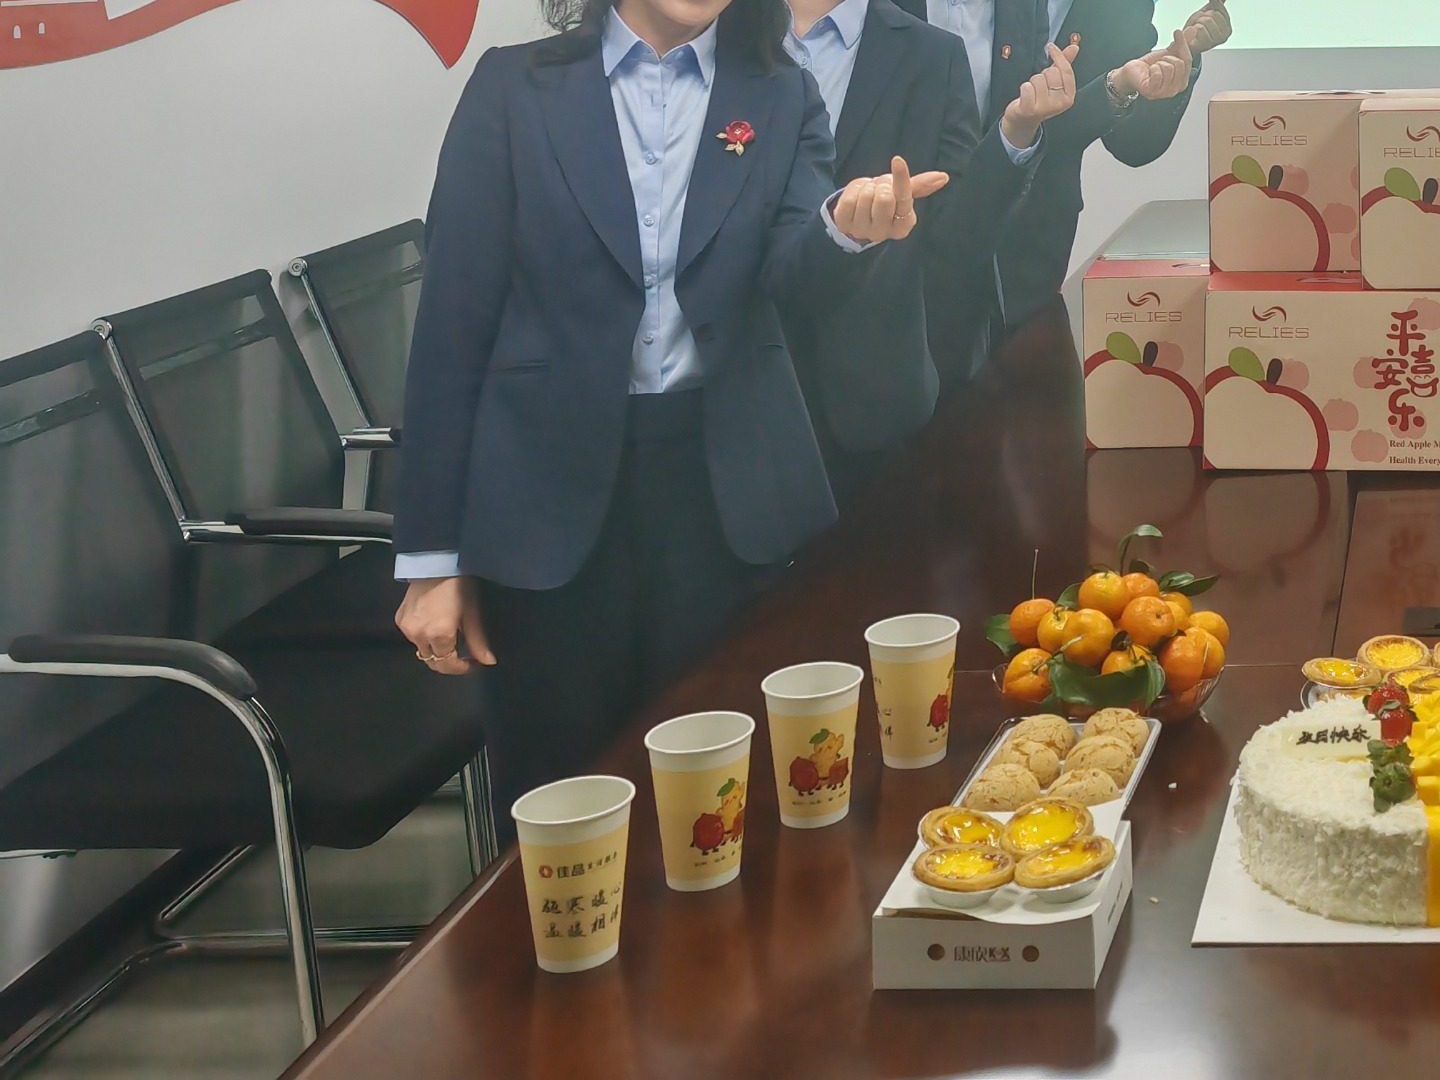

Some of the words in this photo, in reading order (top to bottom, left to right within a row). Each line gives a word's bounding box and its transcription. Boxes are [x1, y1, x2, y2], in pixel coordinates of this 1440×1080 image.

[1231, 135, 1308, 146] RELIES
[1105, 311, 1183, 323] RELIES
[1228, 326, 1310, 339] RELIES
[1389, 440, 1405, 448] Red
[1407, 440, 1431, 450] Apple
[1389, 456, 1416, 465] Health
